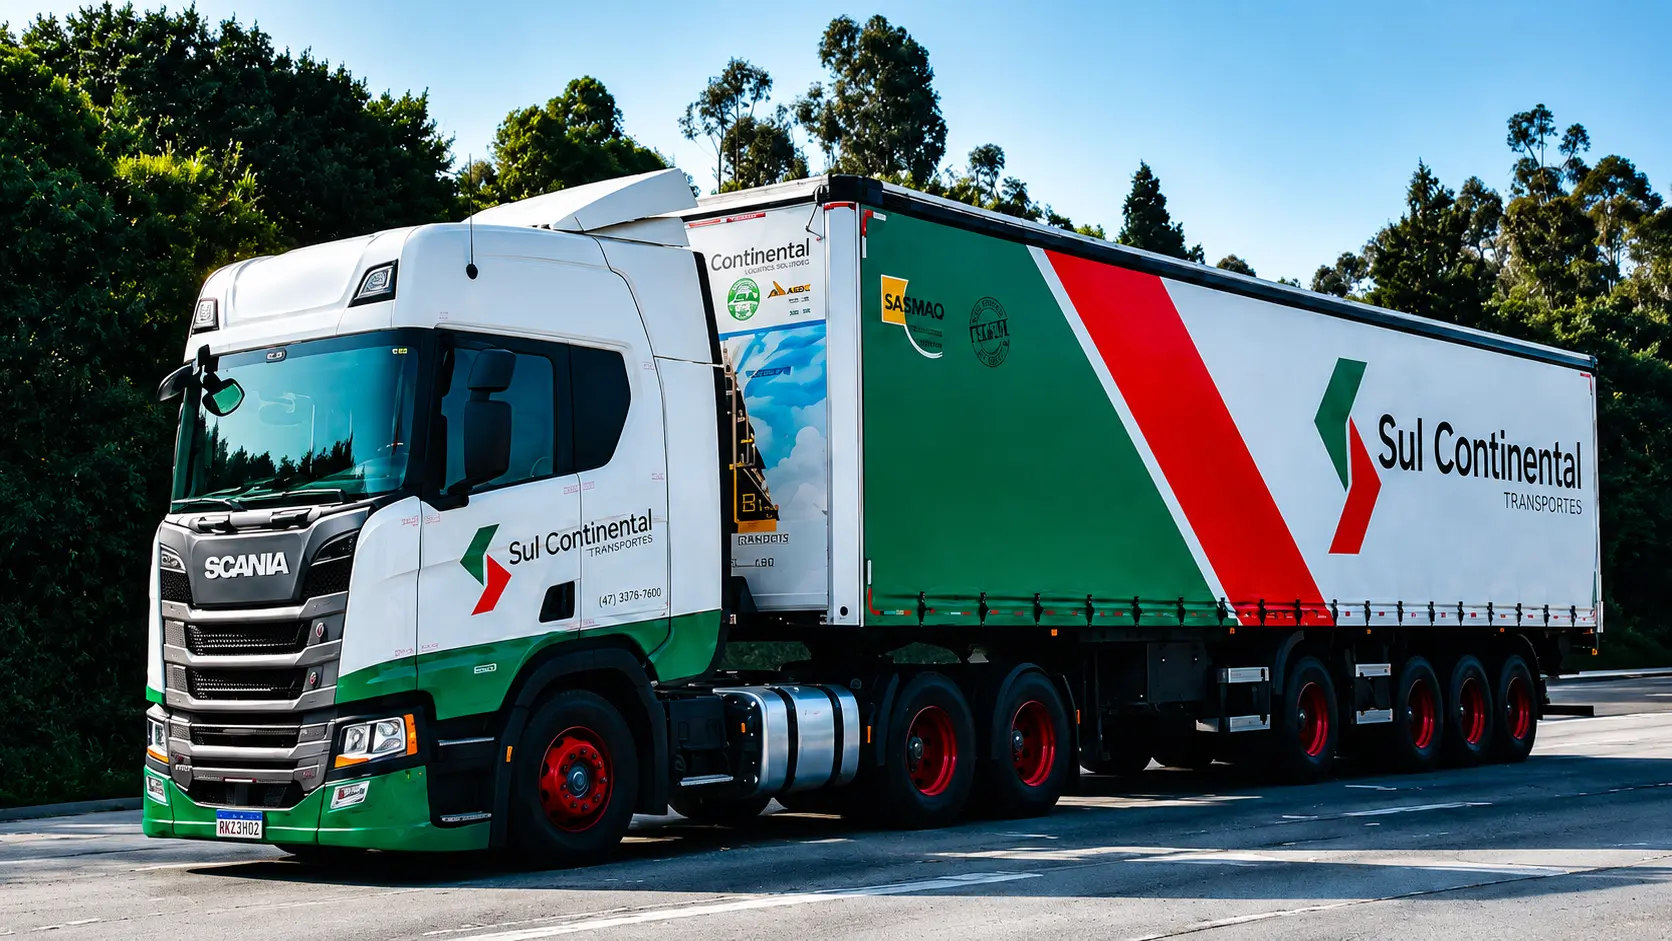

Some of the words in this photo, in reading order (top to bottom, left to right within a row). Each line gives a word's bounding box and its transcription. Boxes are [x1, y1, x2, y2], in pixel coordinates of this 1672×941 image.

[711, 238, 810, 271] Continental
[885, 293, 944, 320] SASMAQ
[1378, 413, 1423, 472] Sul
[1434, 421, 1582, 490] Continental
[1503, 492, 1583, 515] TRANSPORTES
[509, 535, 540, 565] Sul
[545, 508, 652, 555] Continental
[589, 534, 653, 558] TRANSPORTES
[204, 551, 290, 580] SCANIA
[599, 594, 616, 608] (47)
[219, 821, 260, 836] RKZ3H02
